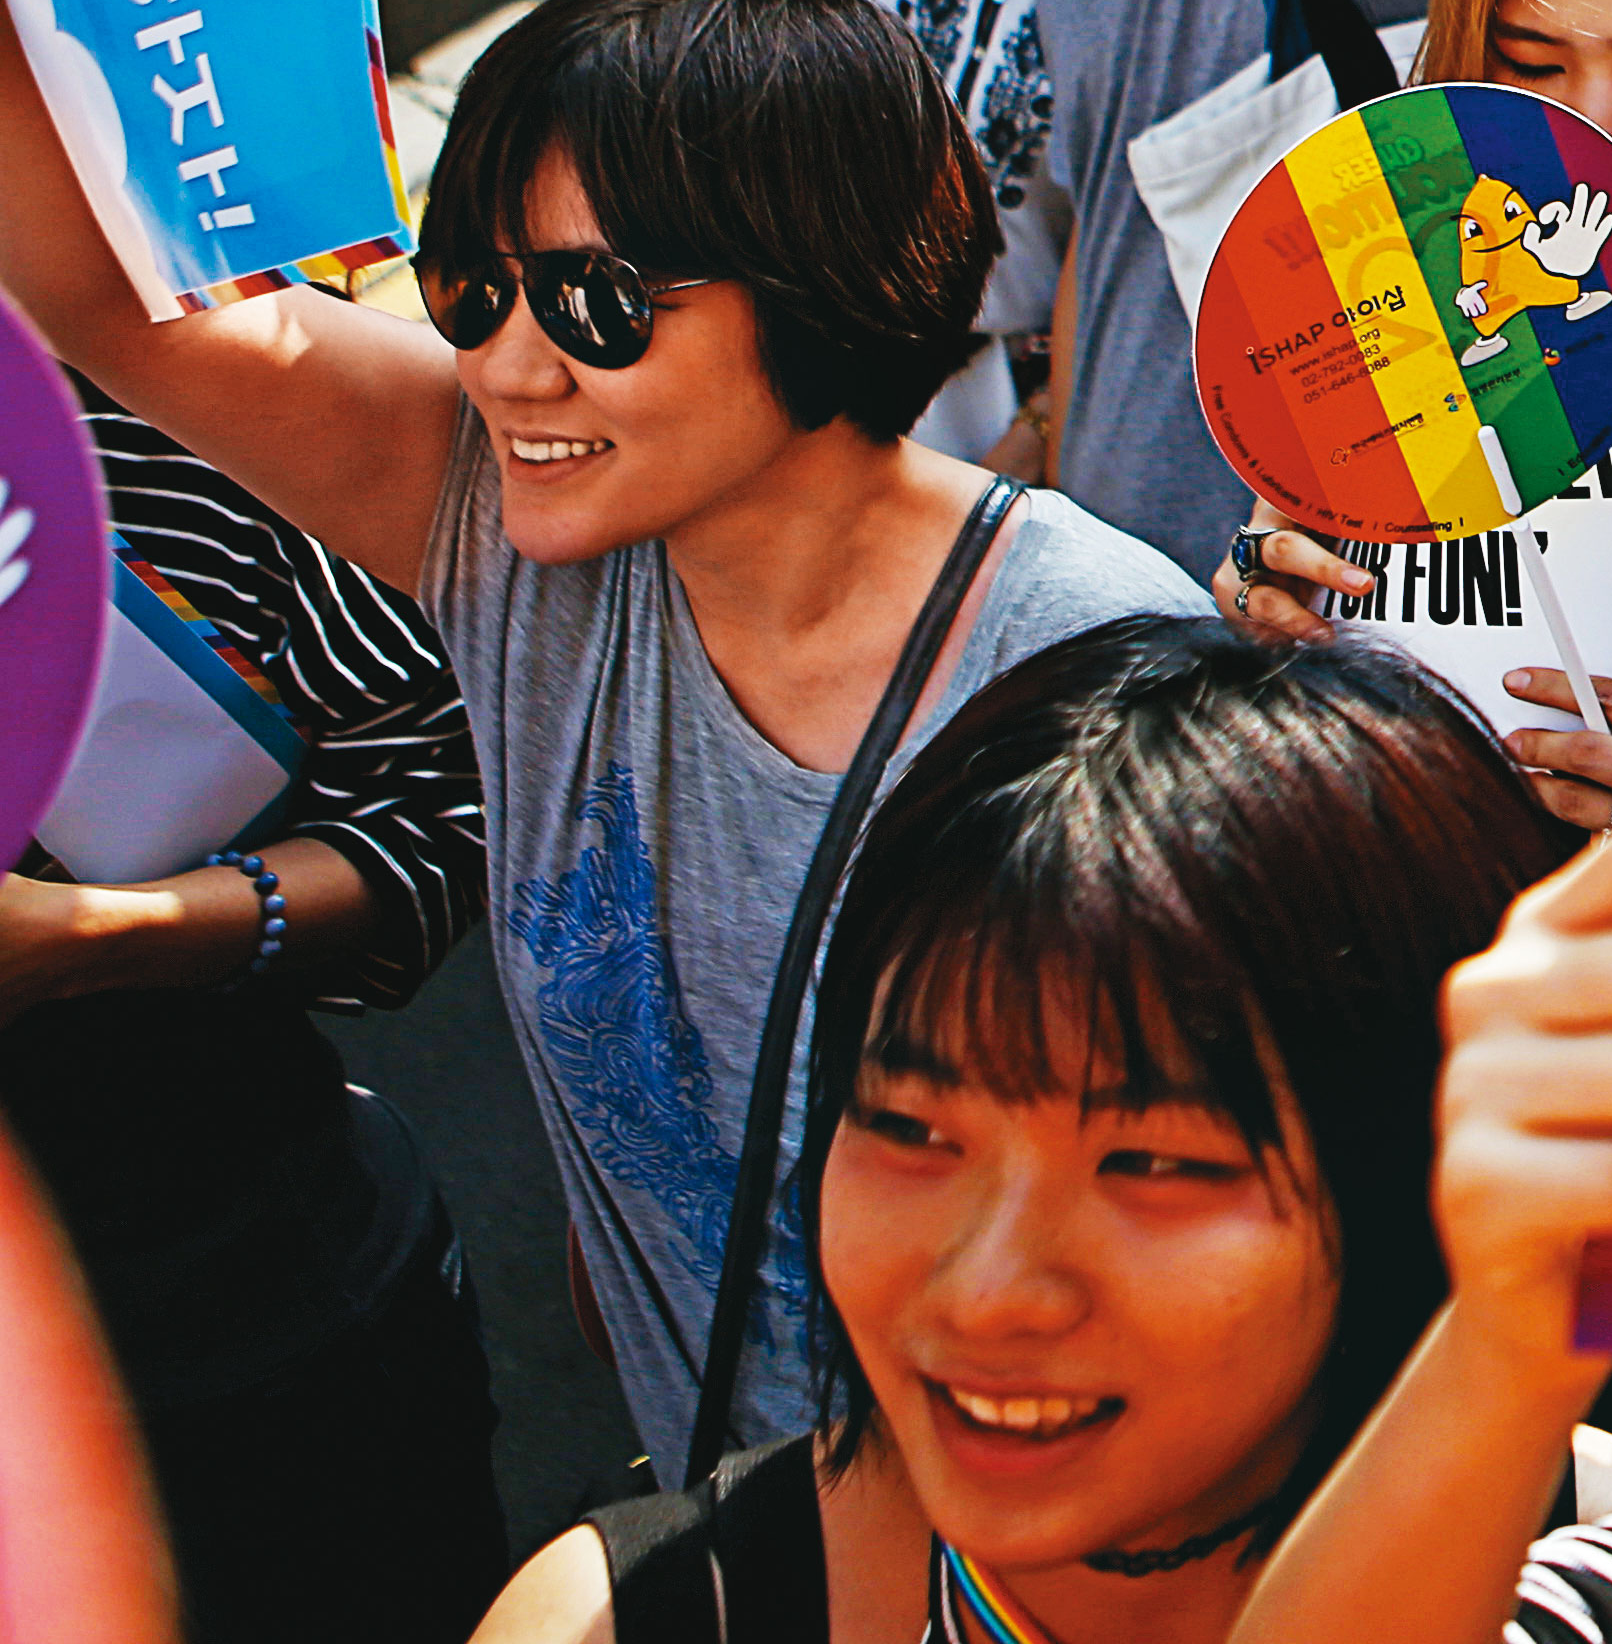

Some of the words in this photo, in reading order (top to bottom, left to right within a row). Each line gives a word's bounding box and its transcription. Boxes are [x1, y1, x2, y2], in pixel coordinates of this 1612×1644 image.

[1246, 322, 1325, 375] iSHAP
[1332, 284, 1407, 329] 아이샵
[1289, 327, 1382, 376] www.ishap.org
[1300, 344, 1382, 388] 02-792-0083
[1303, 356, 1392, 404] 051-646-8088
